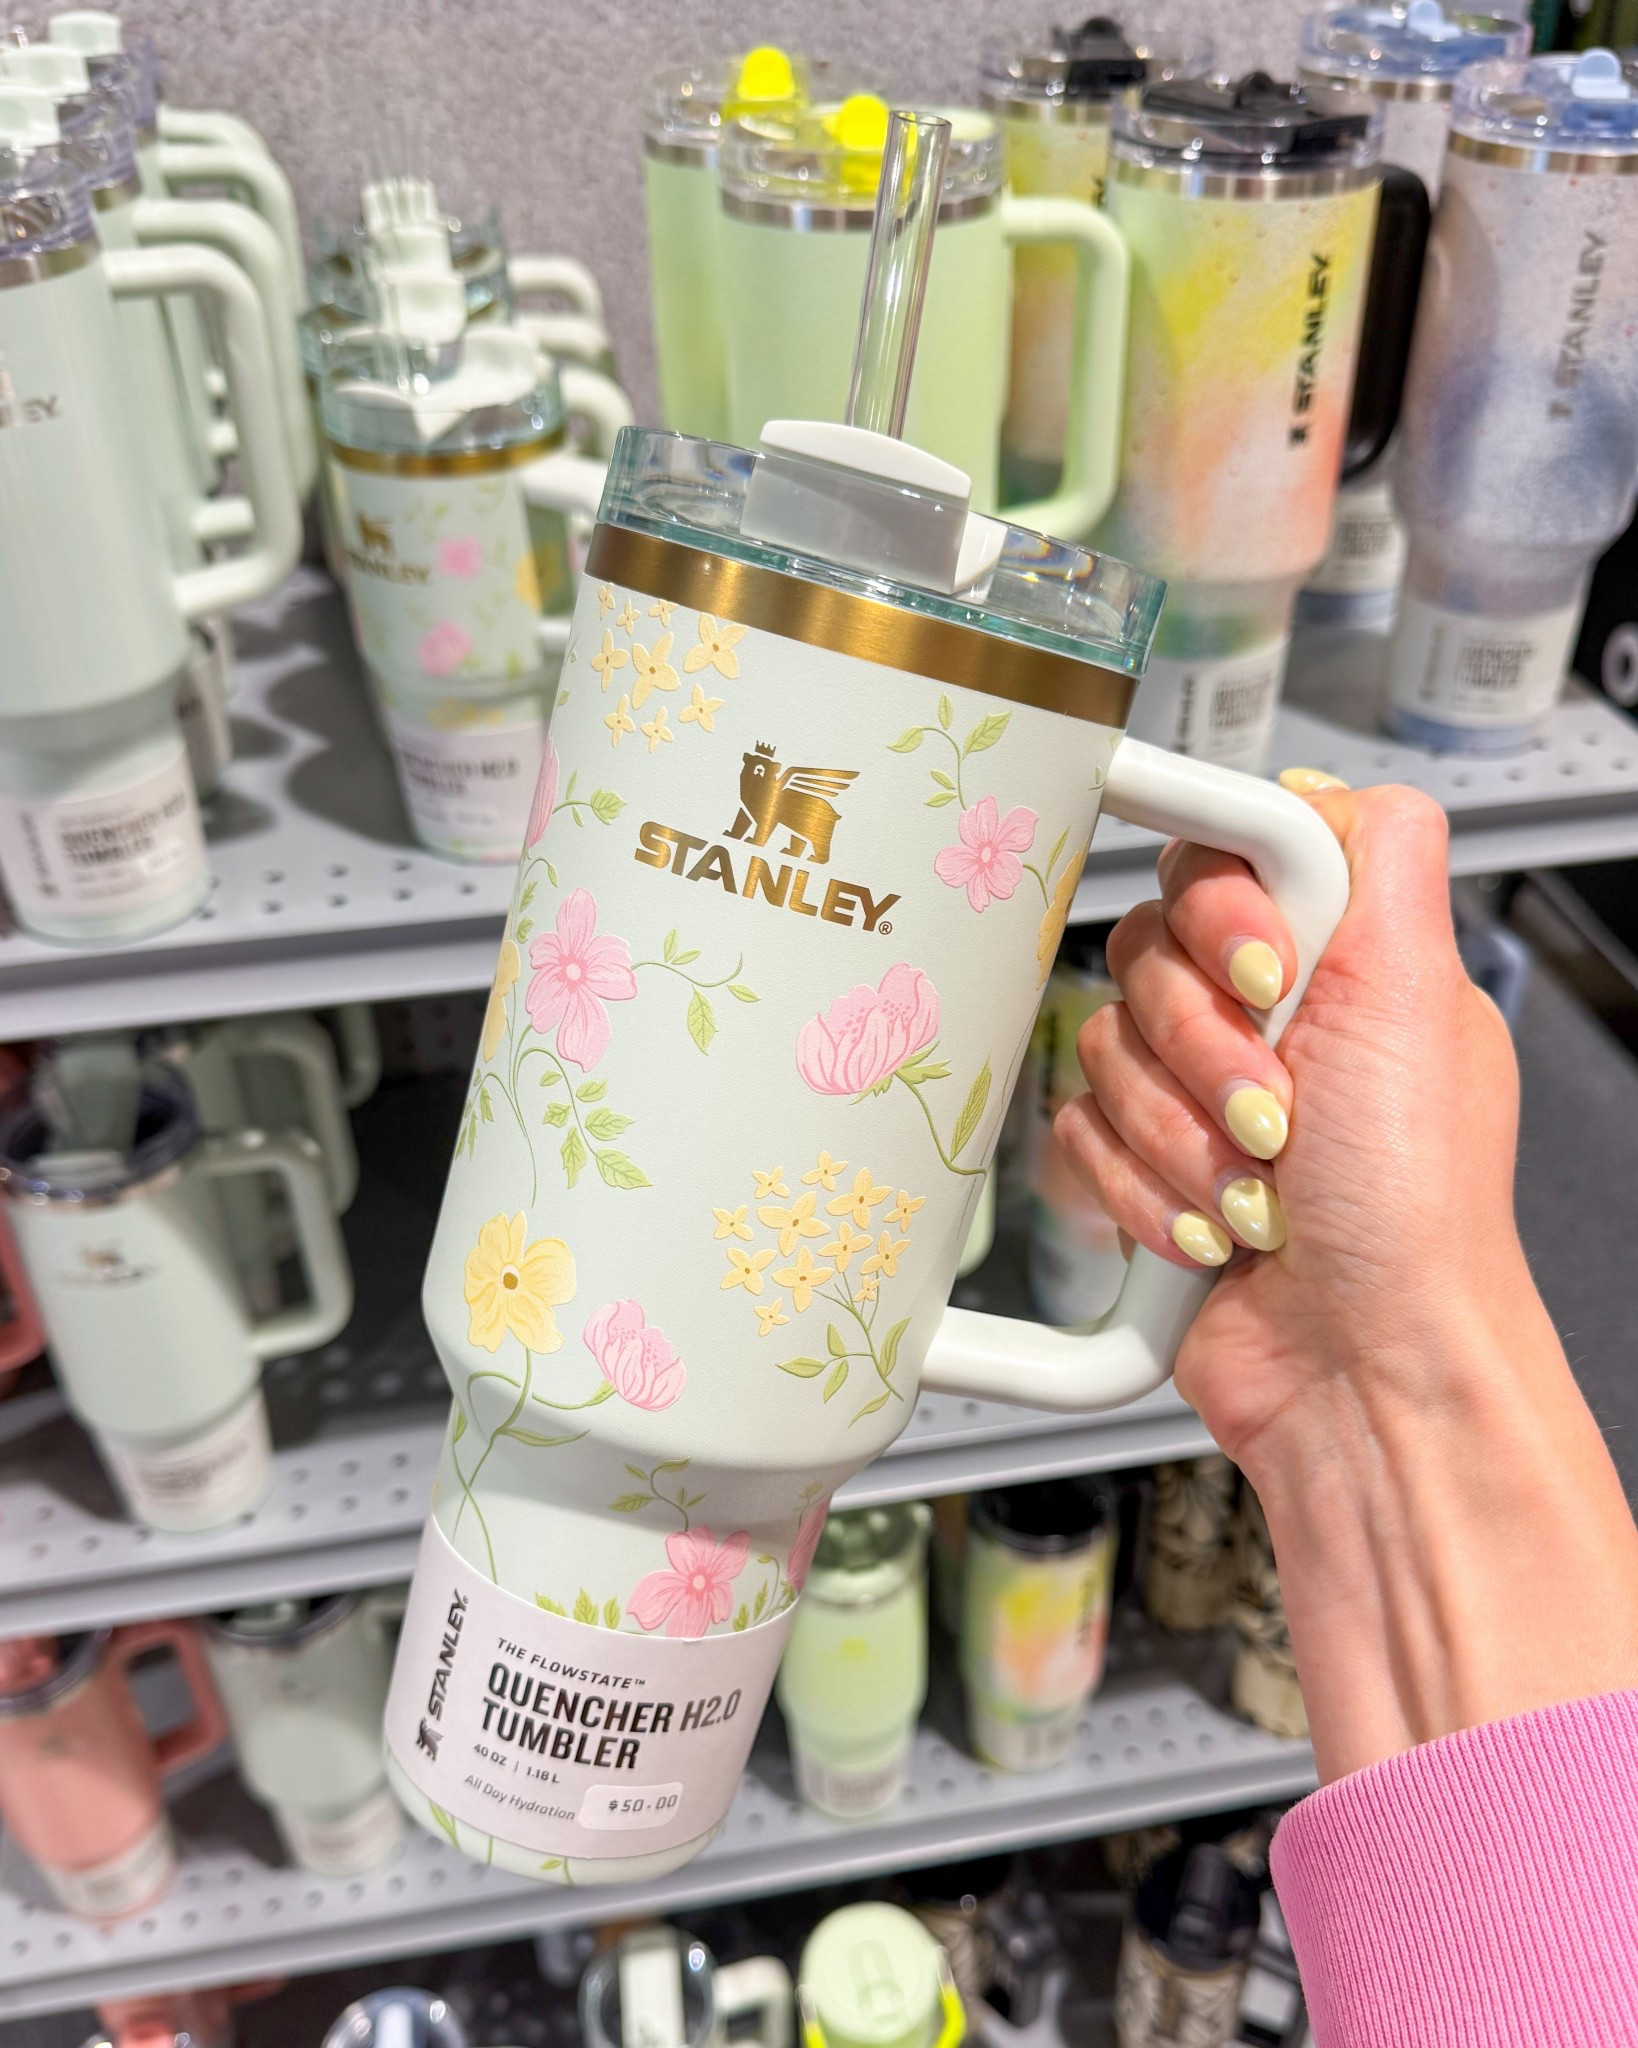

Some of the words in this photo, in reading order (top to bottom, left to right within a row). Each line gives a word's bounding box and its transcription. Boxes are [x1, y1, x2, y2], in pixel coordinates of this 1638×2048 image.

[1292, 252, 1329, 414] STANLEY
[1554, 230, 1606, 388] STANLEY
[496, 1637, 528, 1660] THE
[488, 1661, 675, 1733] QUENCHER
[680, 1688, 742, 1732] H2.0
[481, 1696, 641, 1770] TUMBLER
[473, 1743, 489, 1758] 40
[526, 1766, 549, 1782] 1.18
[550, 1773, 560, 1784] L
[464, 1774, 481, 1791] All
[483, 1783, 507, 1803] Day
[509, 1793, 576, 1821] Hydration
[608, 1794, 679, 1813] $50.00
